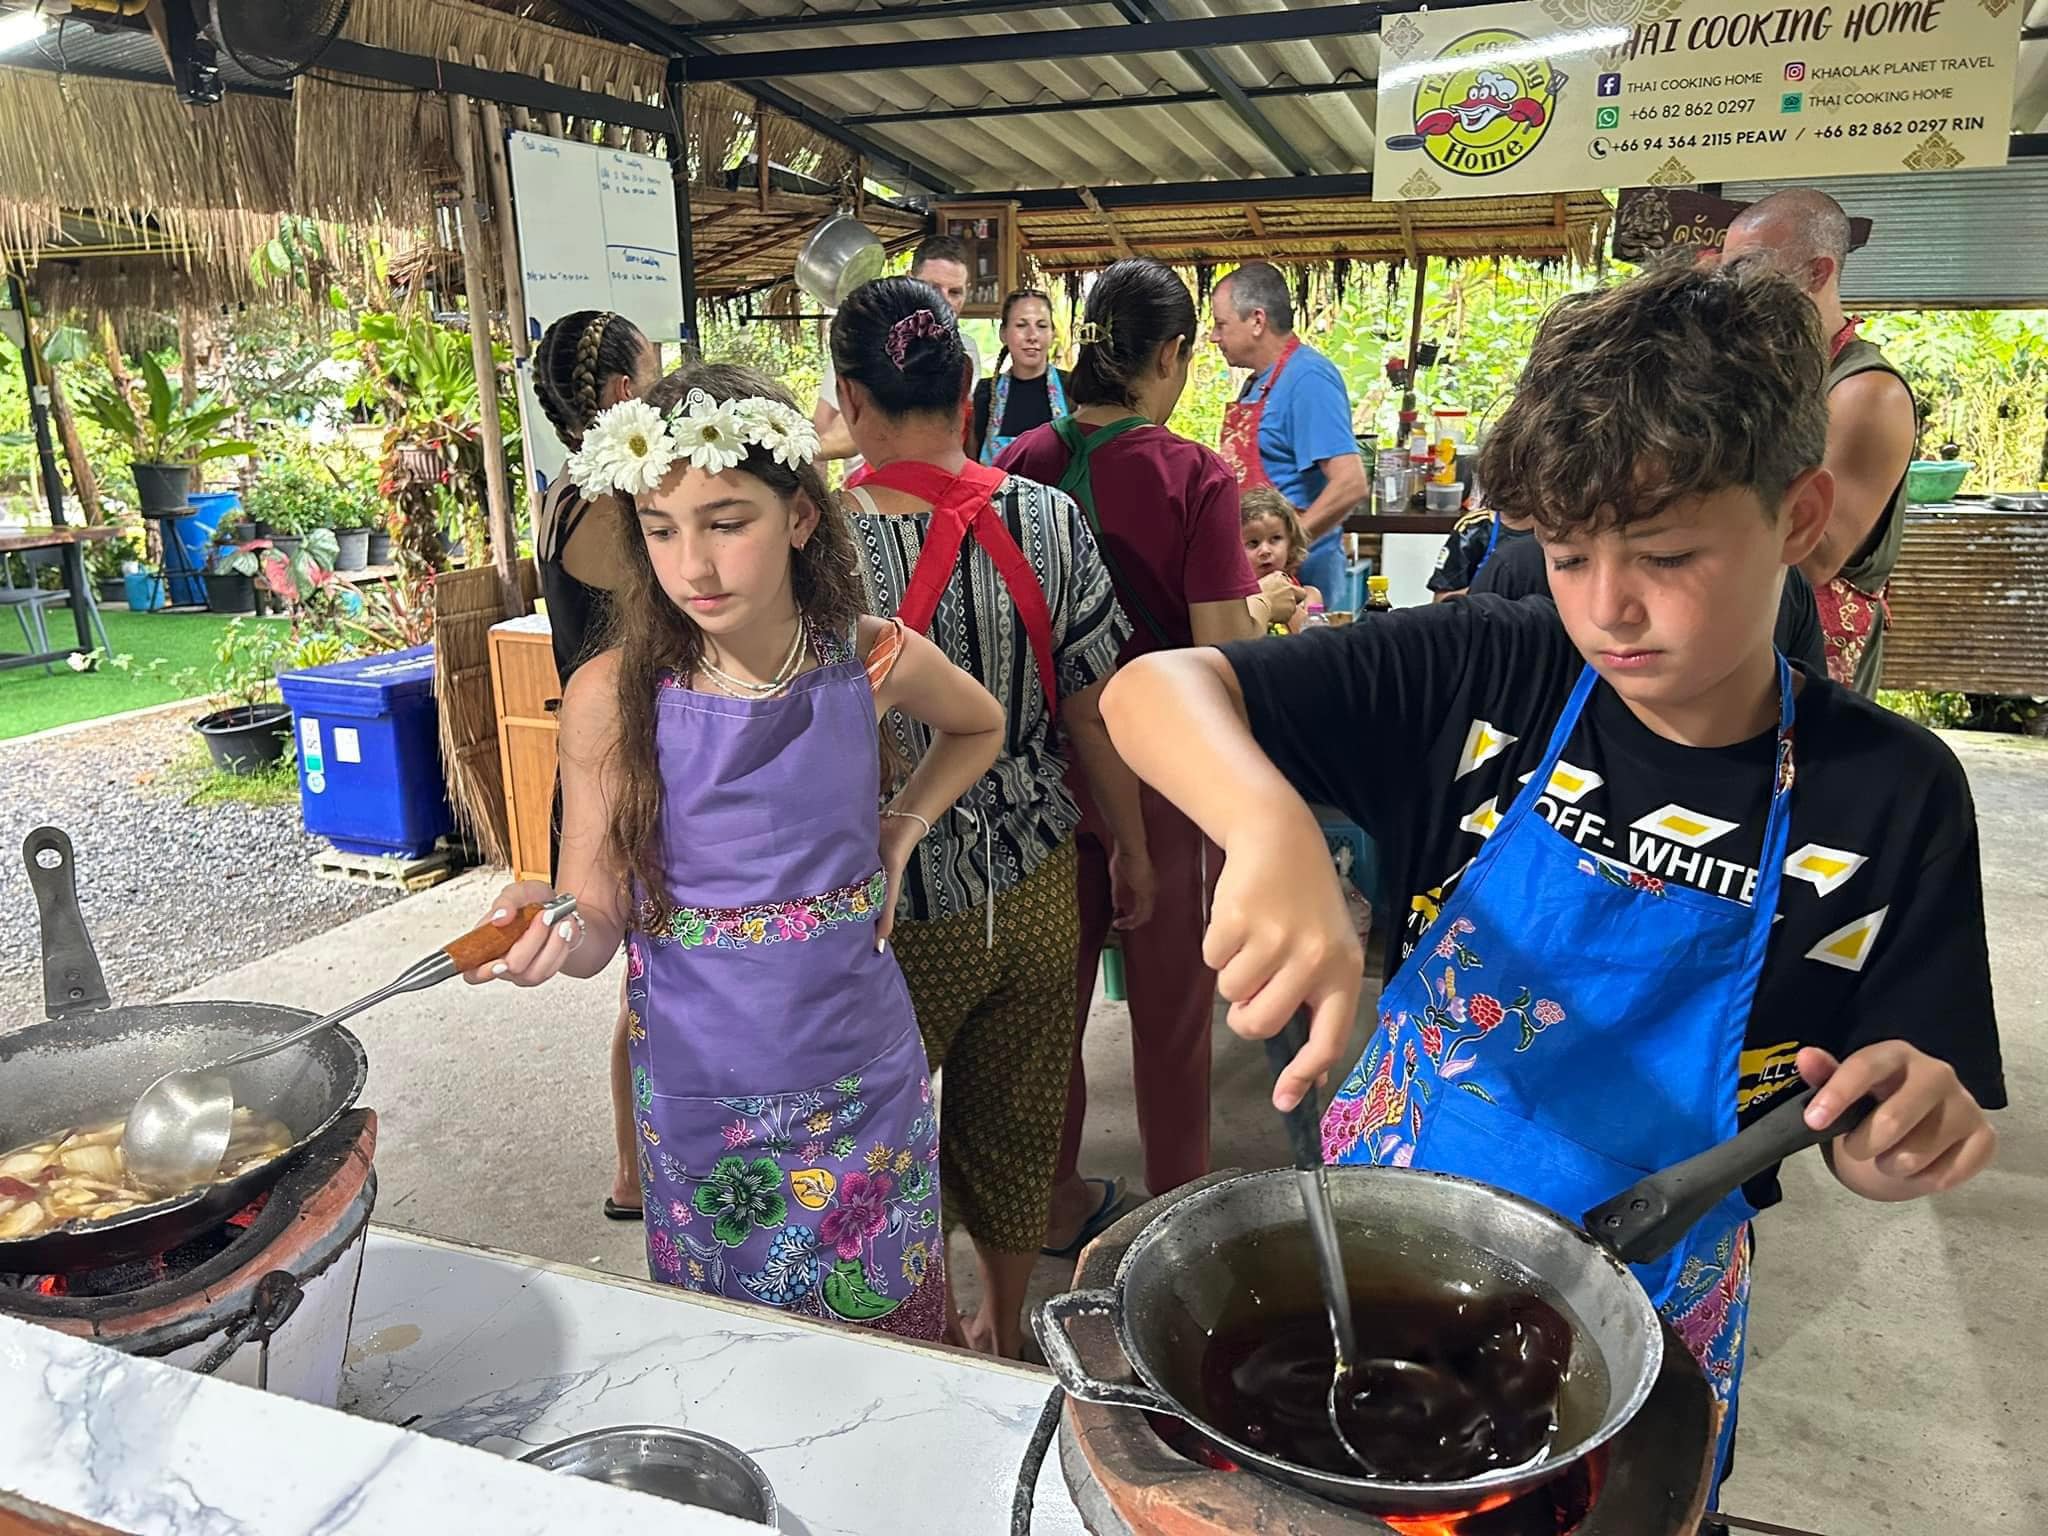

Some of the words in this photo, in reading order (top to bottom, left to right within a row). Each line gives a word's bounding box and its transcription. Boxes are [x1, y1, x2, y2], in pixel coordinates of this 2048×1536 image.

[1609, 19, 1682, 61] HAI
[1687, 6, 1833, 51] COOKING
[1843, 0, 1945, 43] HOME
[1811, 63, 1880, 80] KHAOLAK
[1883, 59, 1937, 75] PLANET
[1941, 56, 1995, 70] TRAVEL
[1627, 81, 1657, 94] THAI
[1660, 75, 1721, 91] COOKING
[1724, 72, 1763, 85] HOME
[1629, 106, 1658, 121] +66
[1662, 105, 1681, 118] 82
[1684, 102, 1713, 117] 862
[1717, 98, 1756, 114] 0297
[1808, 94, 1841, 107] THAI
[1844, 90, 1909, 105] COOKING
[1912, 87, 1953, 100] HOME
[1611, 139, 1639, 152] +66
[1643, 137, 1663, 150] 94
[1668, 136, 1697, 149] 364
[1701, 132, 1732, 147] 2115
[1736, 129, 1788, 144] PEAW
[1814, 125, 1843, 138] +66
[1848, 123, 1868, 136] 82
[1872, 121, 1903, 135] 862
[1907, 118, 1948, 133] 0297
[1952, 116, 1985, 131] RIN
[1443, 140, 1524, 170] Home
[1629, 831, 1760, 903] WHITE
